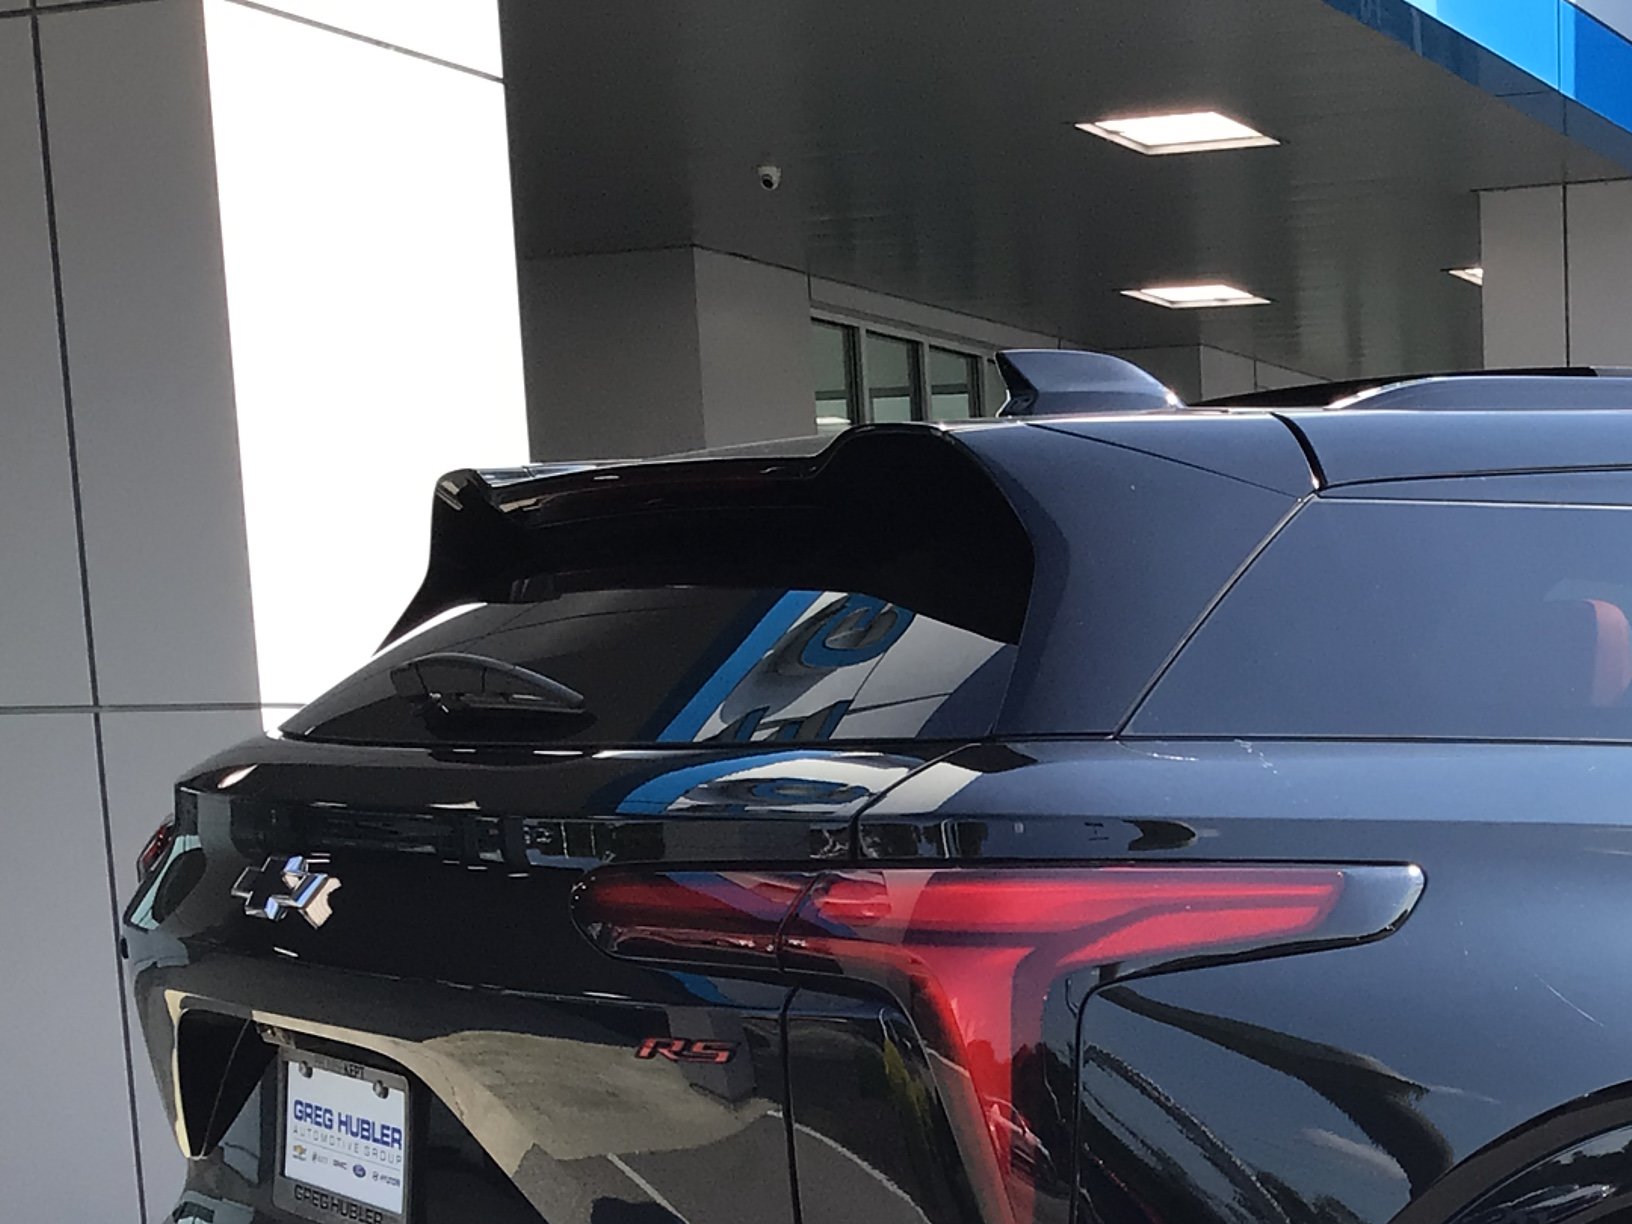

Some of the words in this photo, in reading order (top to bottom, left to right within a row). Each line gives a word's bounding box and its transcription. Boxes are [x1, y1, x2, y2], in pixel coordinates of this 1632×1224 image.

[634, 1036, 736, 1065] RS
[343, 1062, 365, 1080] KEPT
[293, 1099, 334, 1130] GREG
[338, 1111, 402, 1150] HUBLER
[293, 1127, 360, 1155] AUTOMOTIVE
[364, 1145, 402, 1165] GROUP
